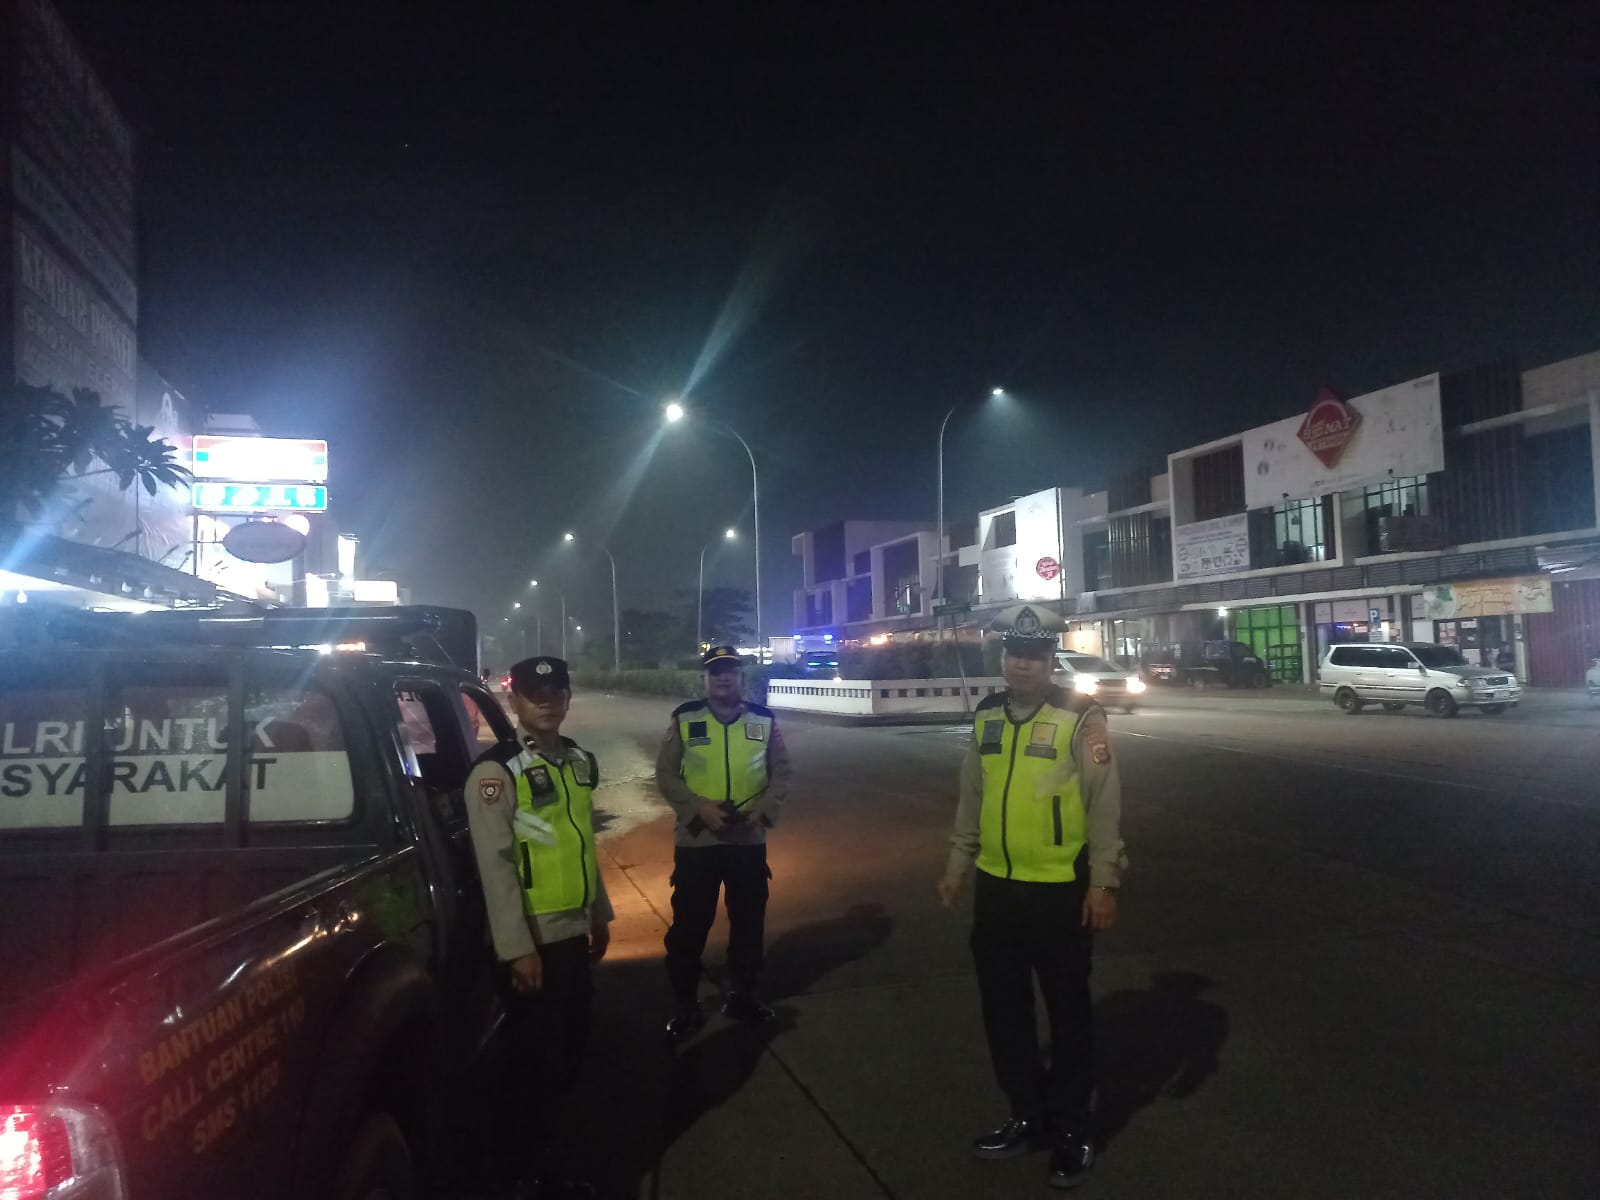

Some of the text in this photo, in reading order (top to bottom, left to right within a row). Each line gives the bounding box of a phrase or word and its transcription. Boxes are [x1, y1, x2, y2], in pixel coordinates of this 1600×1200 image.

[139, 998, 244, 1085] BANTUAN
[142, 1075, 203, 1141] CALL
[206, 1018, 279, 1091] CENTRE
[194, 1098, 236, 1154] SMS
